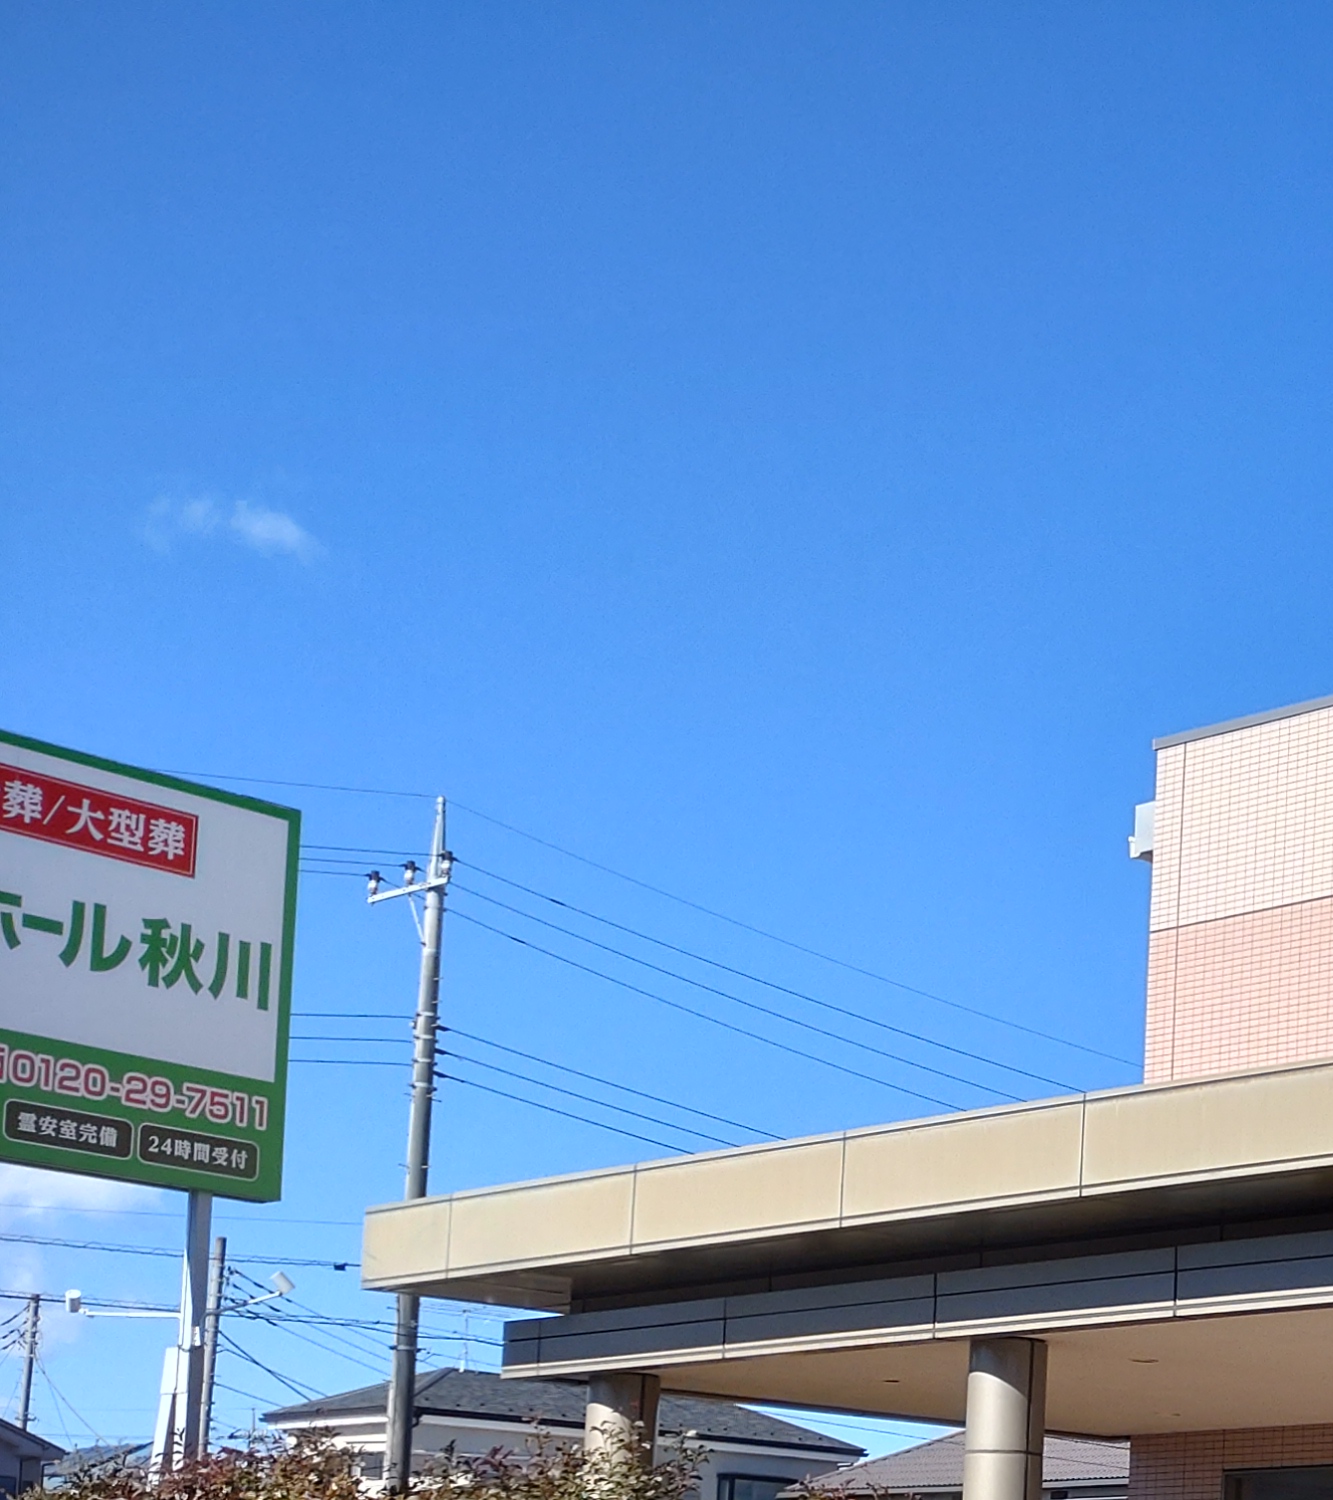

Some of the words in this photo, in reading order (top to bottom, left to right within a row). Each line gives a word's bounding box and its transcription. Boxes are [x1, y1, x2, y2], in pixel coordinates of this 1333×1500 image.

[17, 1112, 118, 1147] 霊安室完備
[147, 1135, 249, 1170] 24時間受付
